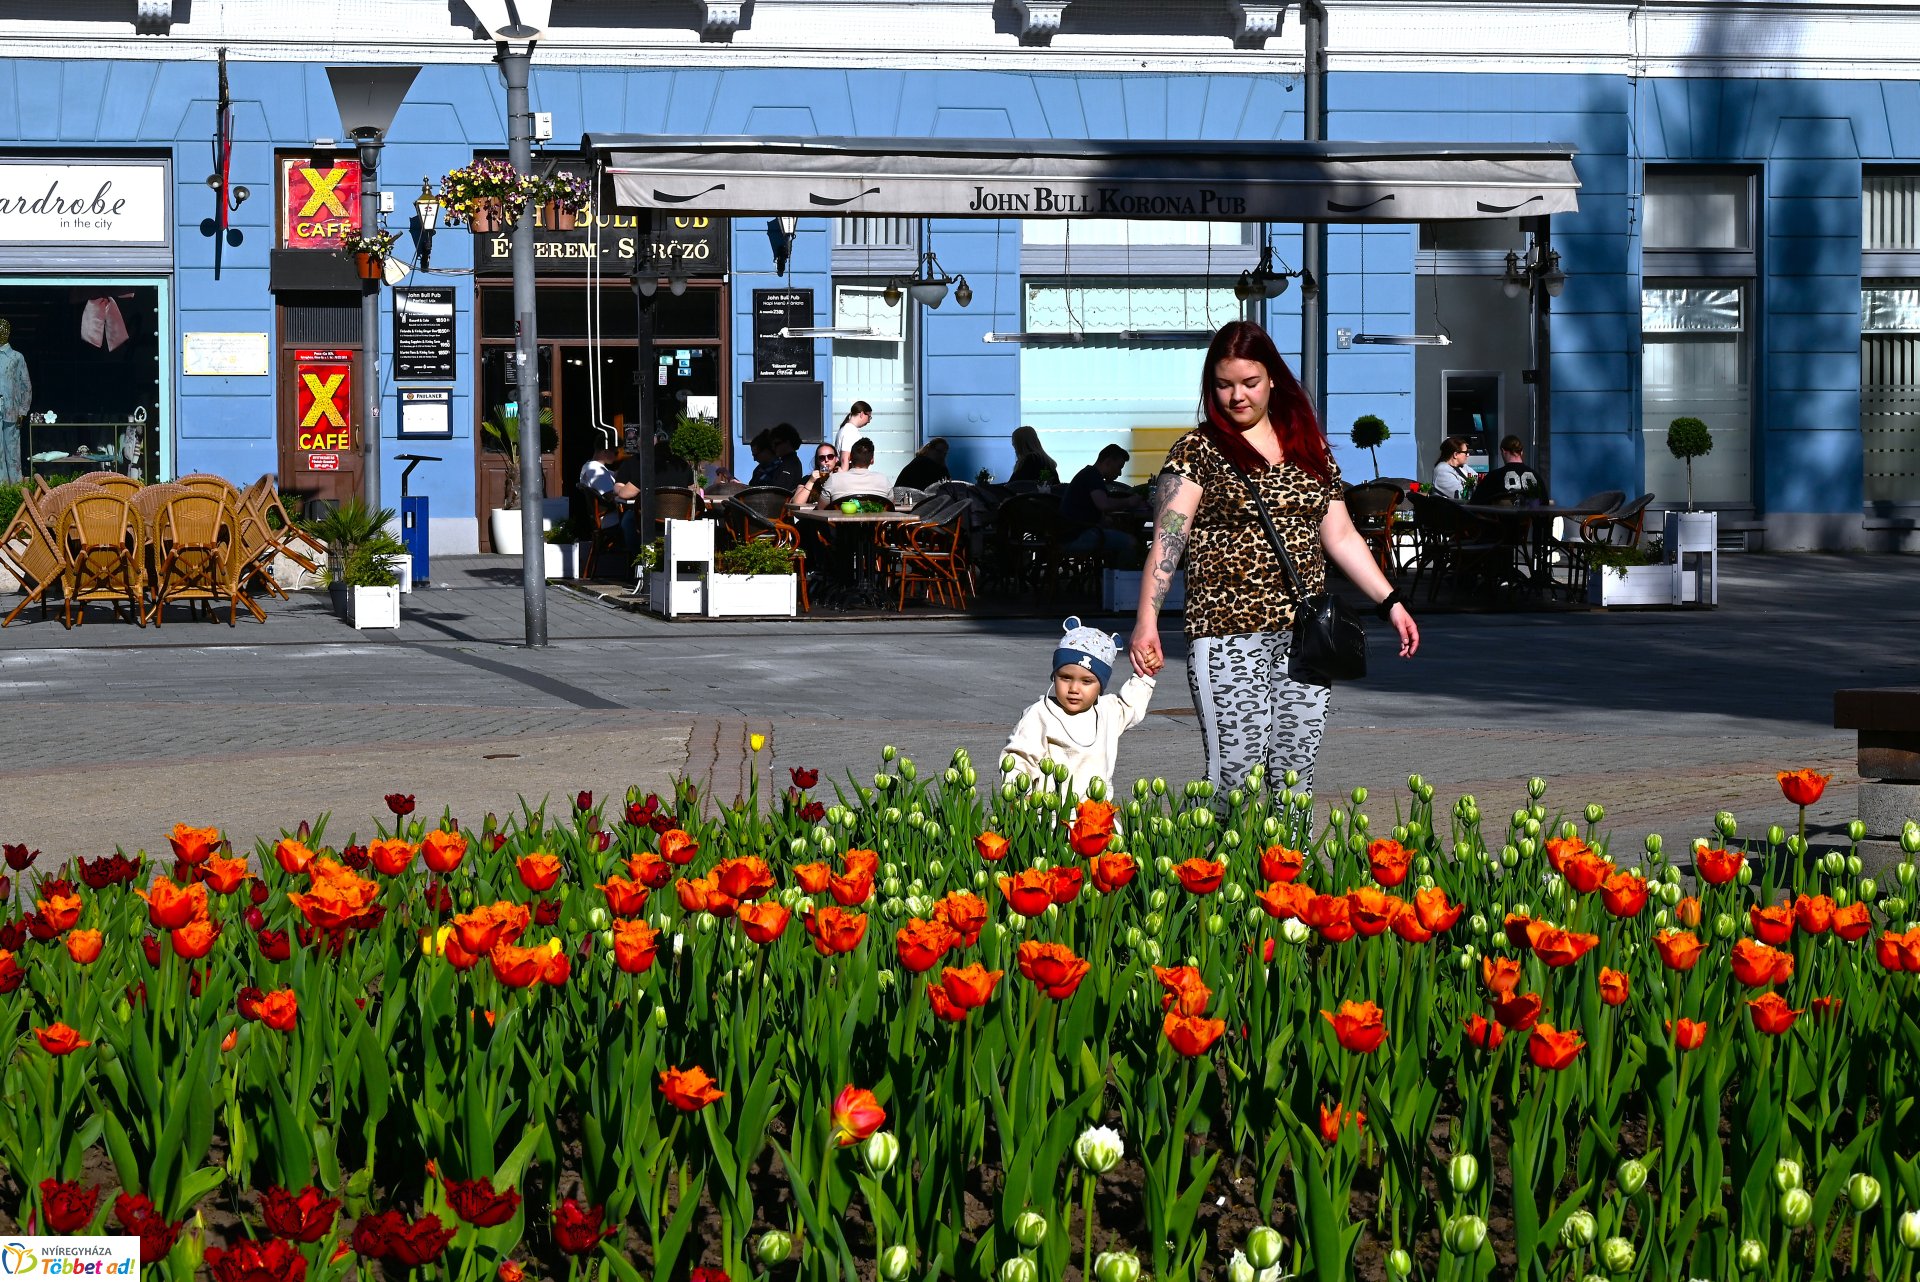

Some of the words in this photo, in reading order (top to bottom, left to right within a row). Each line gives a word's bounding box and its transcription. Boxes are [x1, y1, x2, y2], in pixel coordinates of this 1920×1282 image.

[298, 168, 350, 217] X
[970, 186, 1030, 211] JOHN
[1033, 187, 1095, 212] BULL
[1097, 188, 1200, 214] KORONA
[1199, 189, 1247, 214] PUB
[60, 218, 70, 229] in
[74, 217, 91, 229] the
[94, 218, 113, 231] city
[297, 220, 352, 238] CAFÉ
[491, 233, 598, 258] ÉEREM
[618, 237, 710, 259] SRÖZŐ
[300, 373, 347, 427] X
[299, 430, 349, 450] CAFÉ
